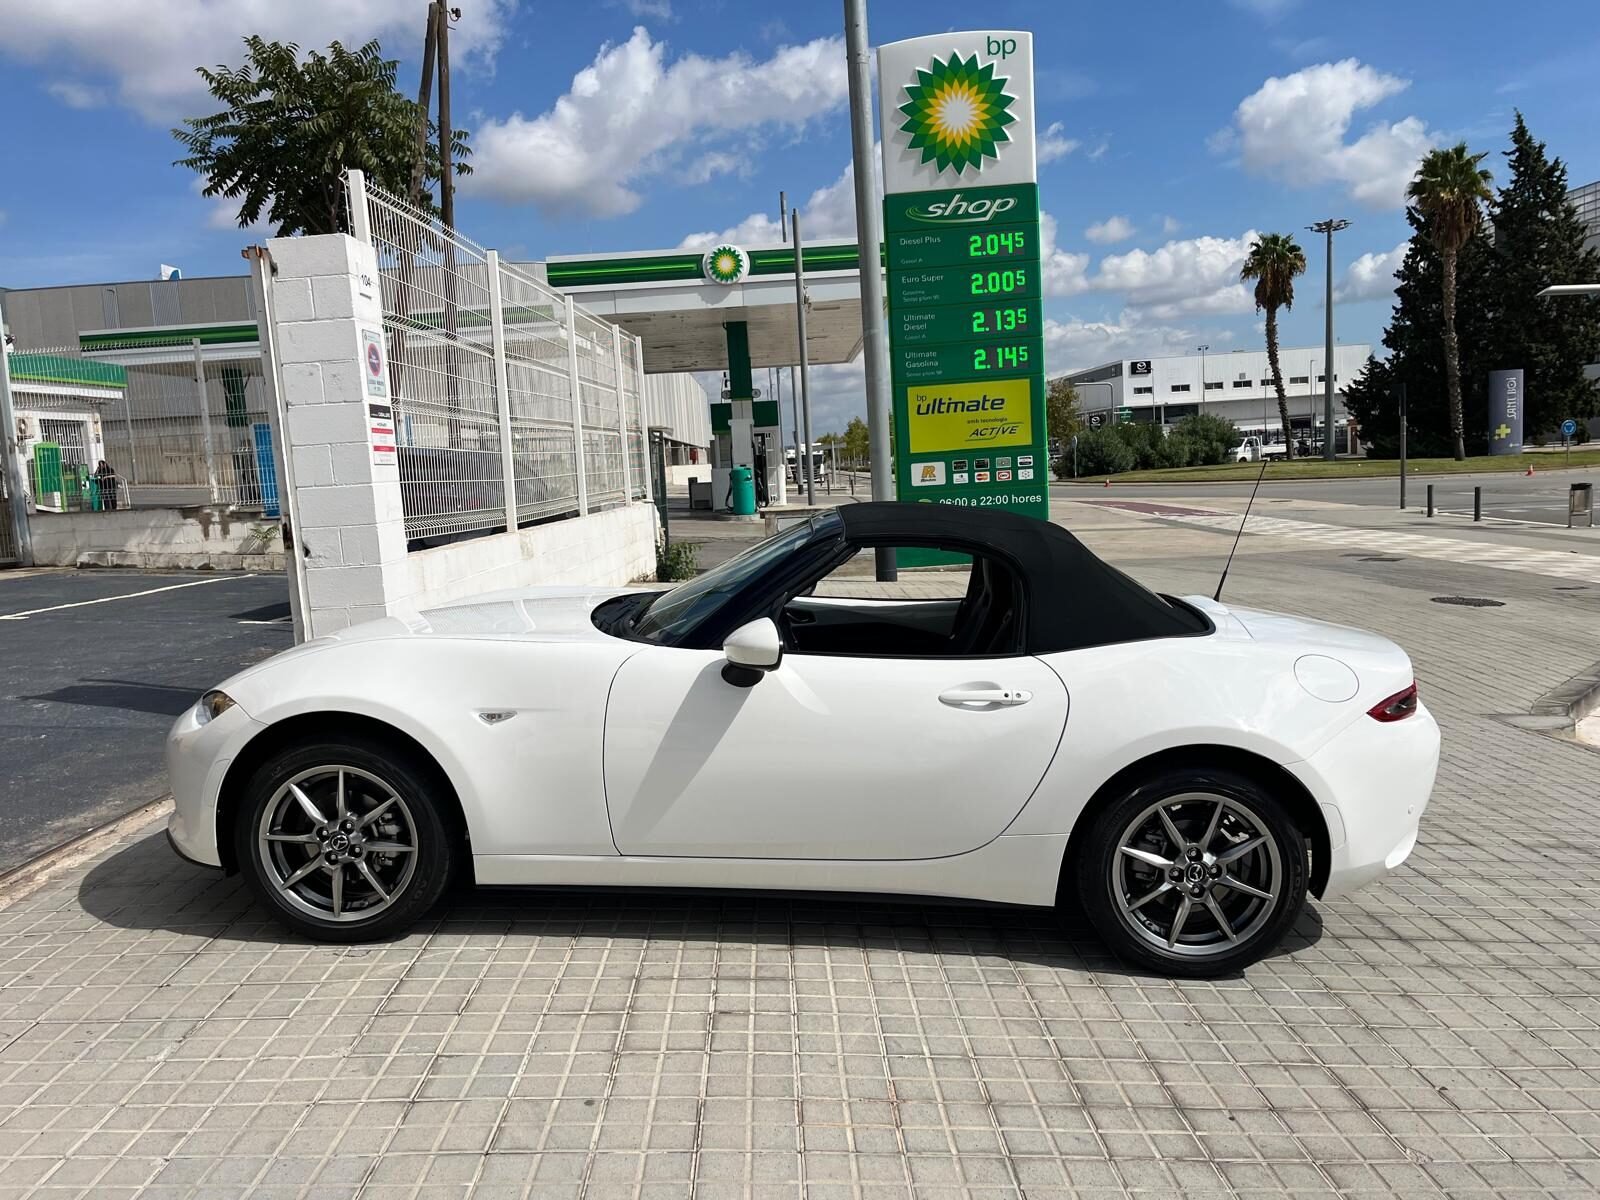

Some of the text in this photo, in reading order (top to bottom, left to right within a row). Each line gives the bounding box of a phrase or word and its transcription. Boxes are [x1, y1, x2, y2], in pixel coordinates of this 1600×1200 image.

[987, 36, 1017, 60] bp
[927, 193, 1018, 222] shop
[899, 235, 942, 246] Diesel Plus
[969, 231, 1025, 257] 2.045
[901, 274, 945, 284] Euro Super
[970, 270, 1026, 295] 2.005
[903, 313, 936, 322] Ultimate
[972, 308, 1027, 332] 2.135
[903, 322, 927, 331] Diesel
[904, 351, 937, 359] Ultimate
[974, 346, 1028, 370] 2.145
[905, 360, 939, 369] Gasolina
[916, 394, 927, 402] bp
[916, 394, 1006, 416] ultimate
[969, 425, 1020, 438] ACTIVE
[970, 499, 977, 507] a
[980, 495, 1009, 506] 22:00
[1011, 494, 1042, 504] hores
